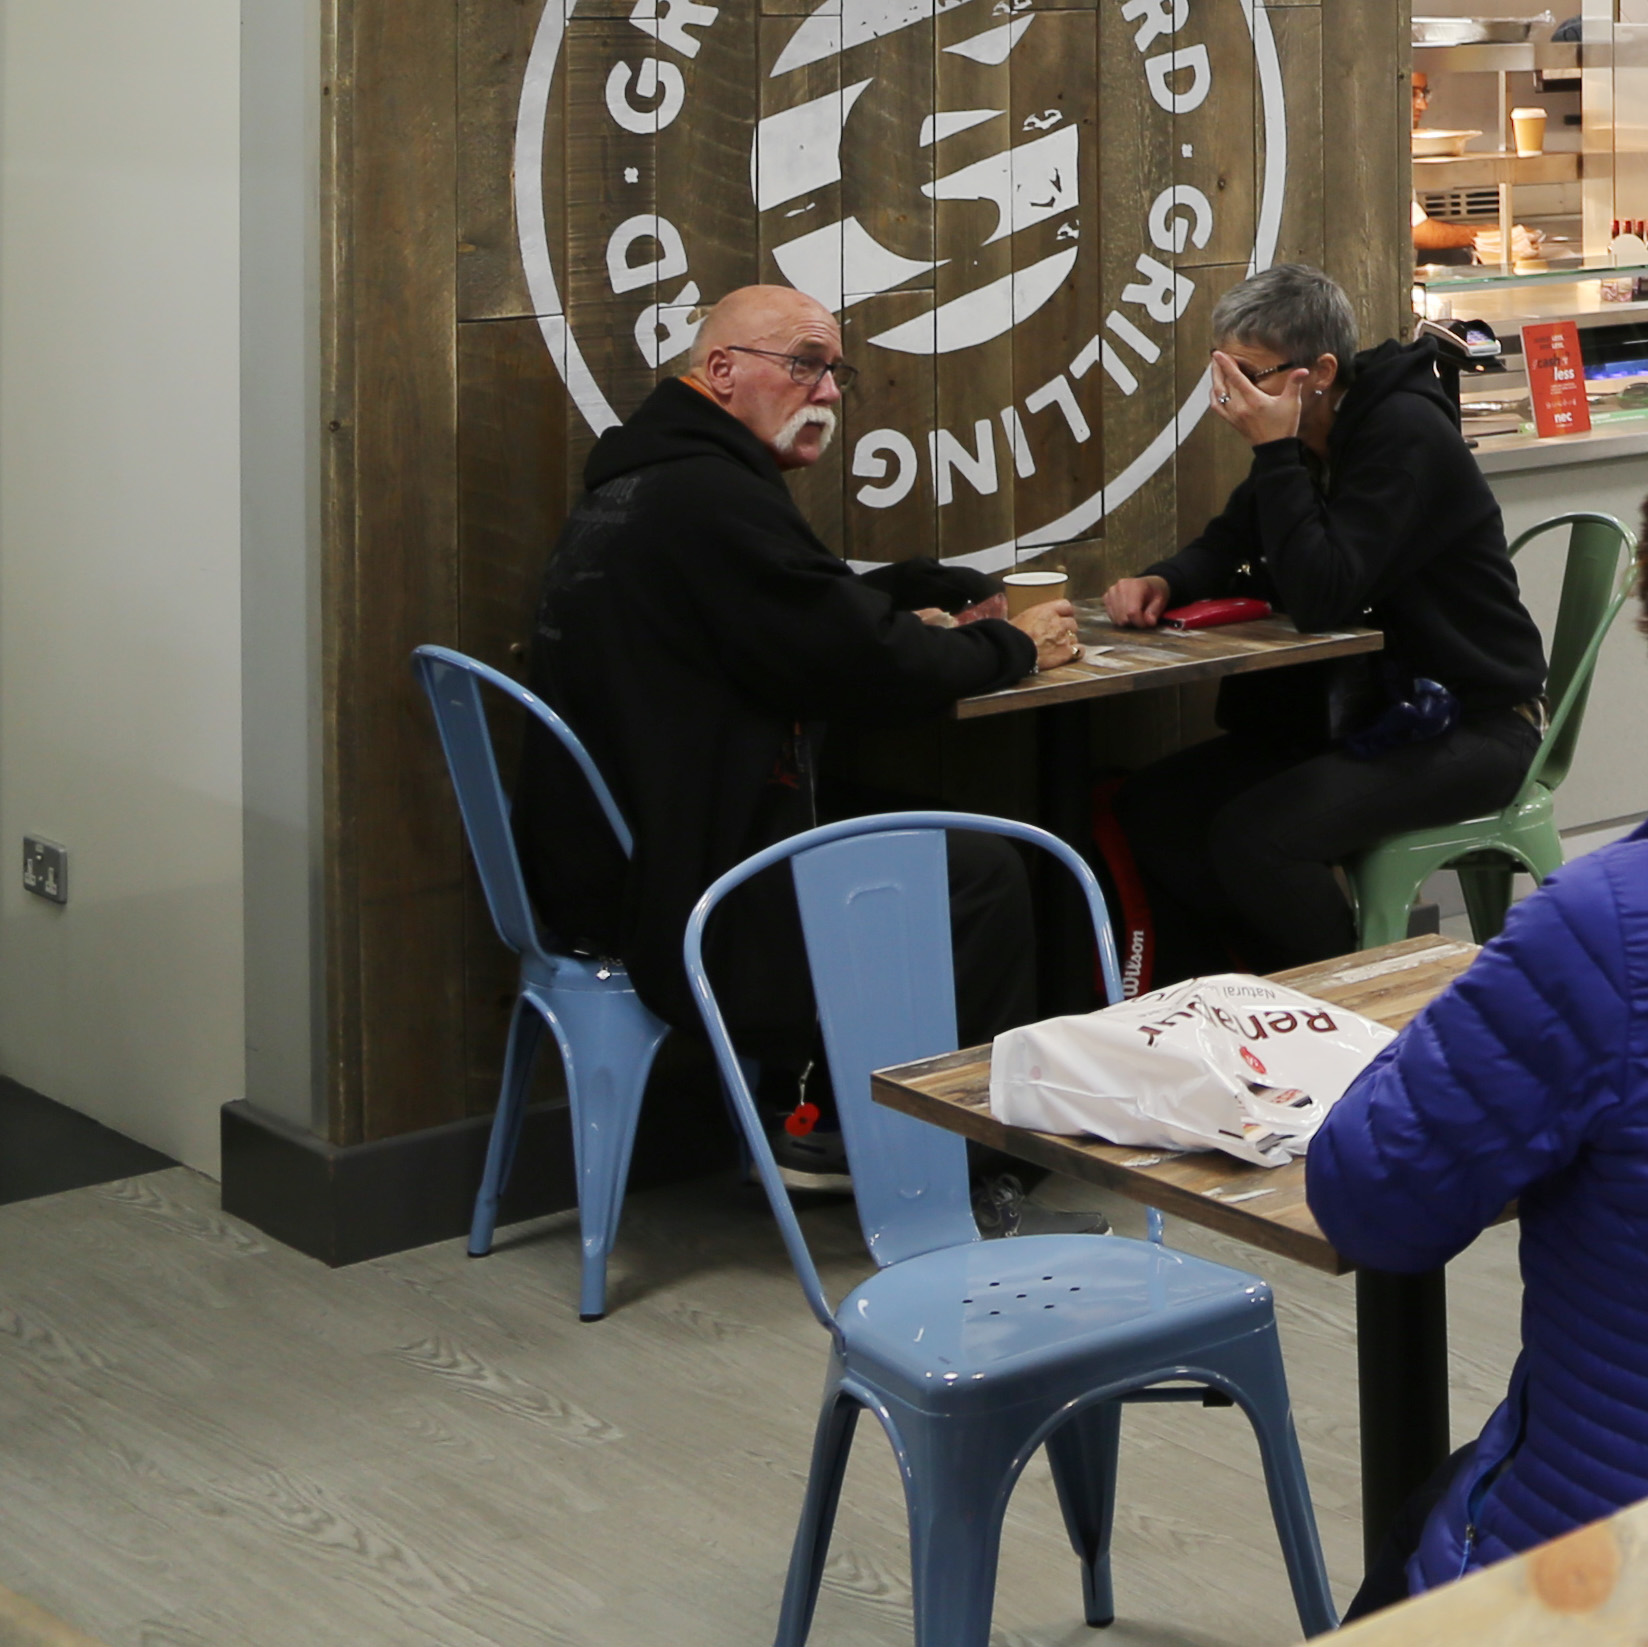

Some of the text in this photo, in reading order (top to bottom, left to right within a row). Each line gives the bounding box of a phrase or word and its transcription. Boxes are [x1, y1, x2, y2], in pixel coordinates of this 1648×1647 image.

[852, 183, 1214, 509] GRILLING
[1553, 366, 1575, 381] less
[1122, 930, 1144, 997] Wilson
[1222, 986, 1276, 1001] Natural
